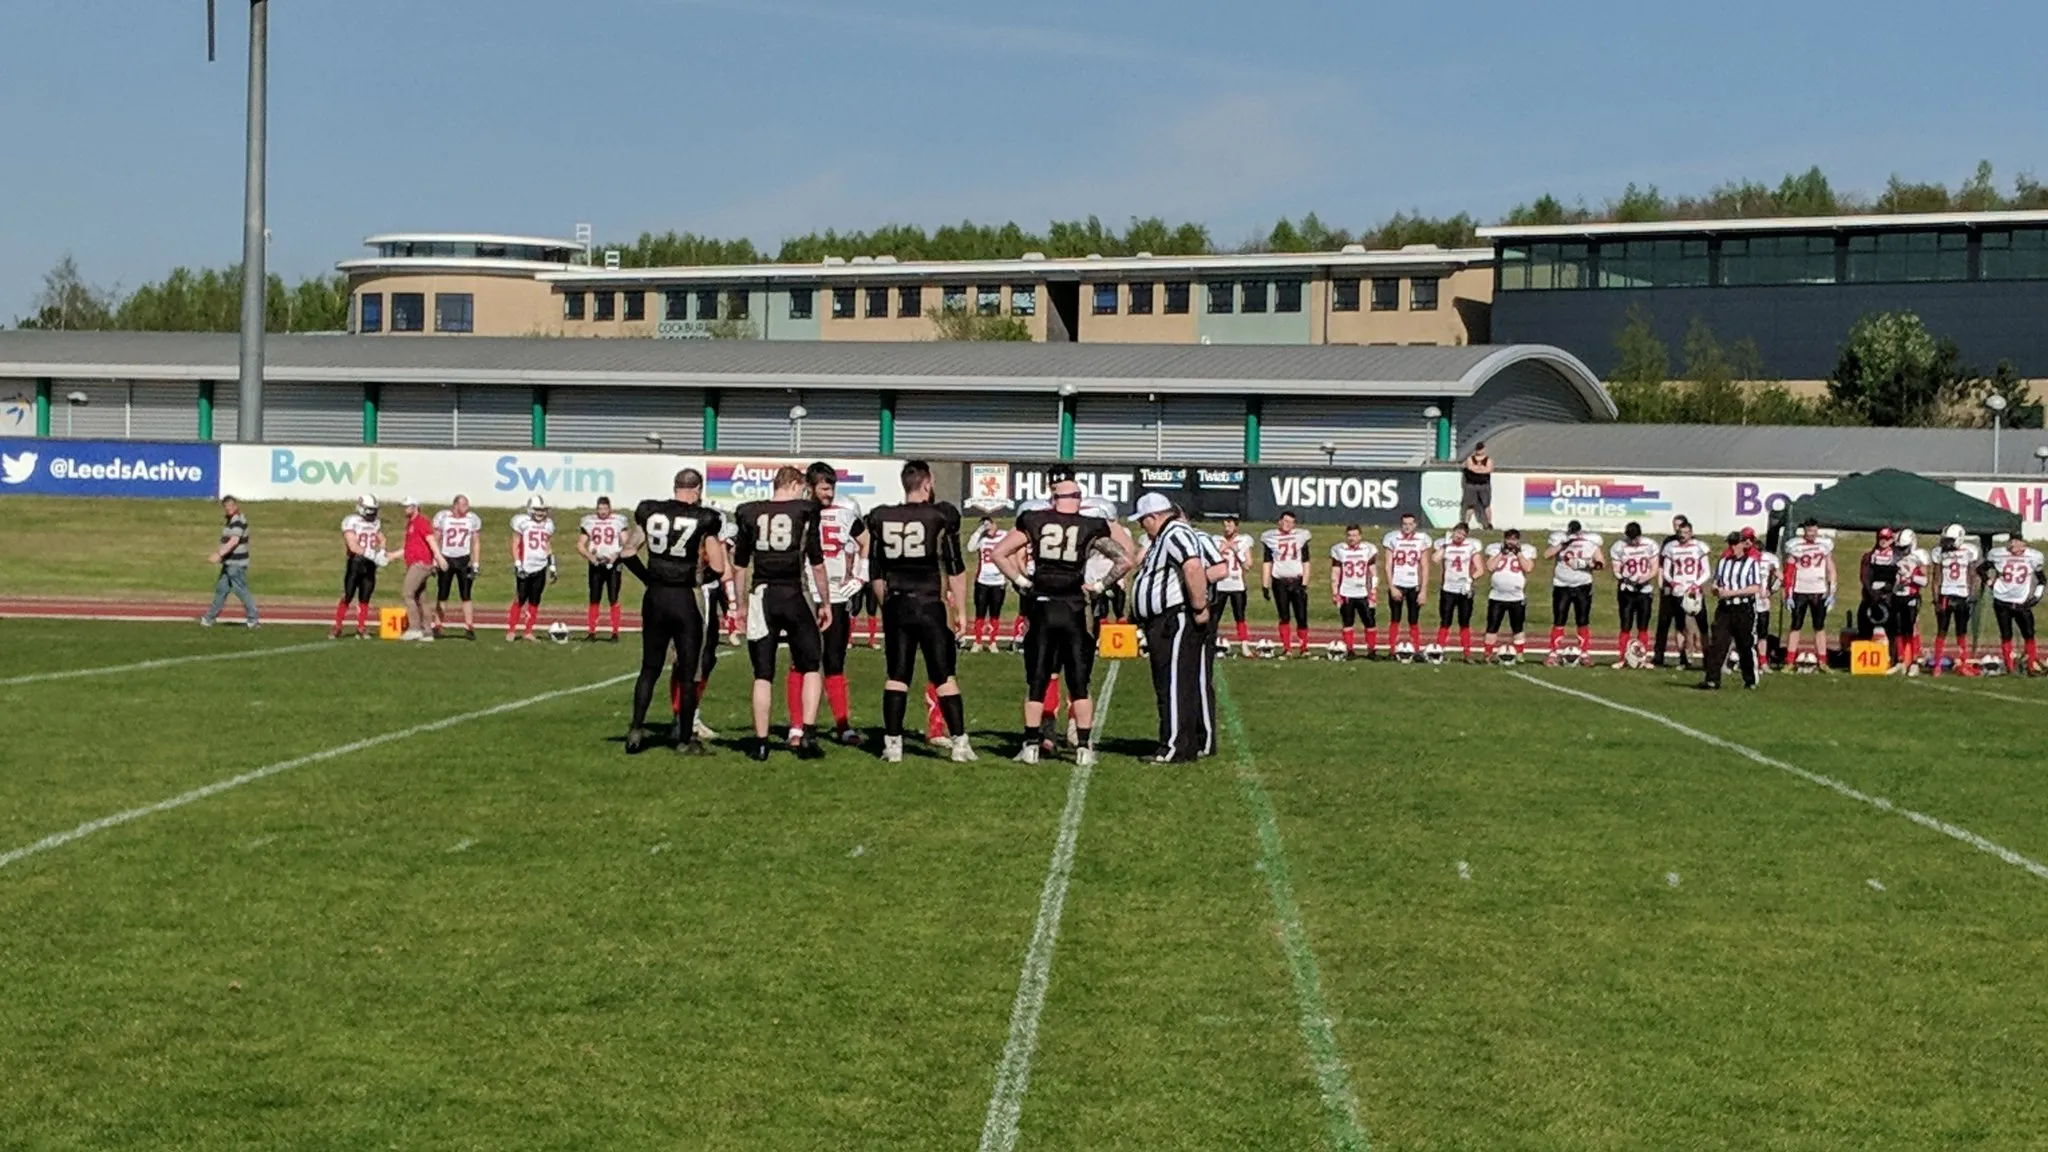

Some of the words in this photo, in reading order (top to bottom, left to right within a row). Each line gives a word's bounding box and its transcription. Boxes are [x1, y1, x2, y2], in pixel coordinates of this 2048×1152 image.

[50, 457, 202, 482] @LeedsActive
[271, 449, 398, 487] Bowls
[494, 455, 614, 492] Swim
[1015, 471, 1134, 503] HUSLET
[1271, 476, 1398, 509] VISITORS
[1551, 479, 1600, 498] John
[1551, 498, 1627, 517] Charles
[445, 527, 469, 548] 27
[528, 531, 549, 551] 55
[591, 526, 615, 545] 69
[646, 513, 698, 557] 87
[756, 513, 793, 551] 18
[882, 520, 925, 558] 52
[1039, 523, 1079, 562] 21
[1279, 543, 1297, 561] 71
[1343, 560, 1366, 578] 33
[1451, 555, 1463, 572] 4
[1626, 557, 1650, 576] 80
[1673, 556, 1696, 576] 18
[1800, 552, 1825, 568] 87
[1949, 562, 1960, 580] 8
[2003, 564, 2029, 584] 63
[1112, 632, 1123, 649] C
[1857, 650, 1880, 668] 40
